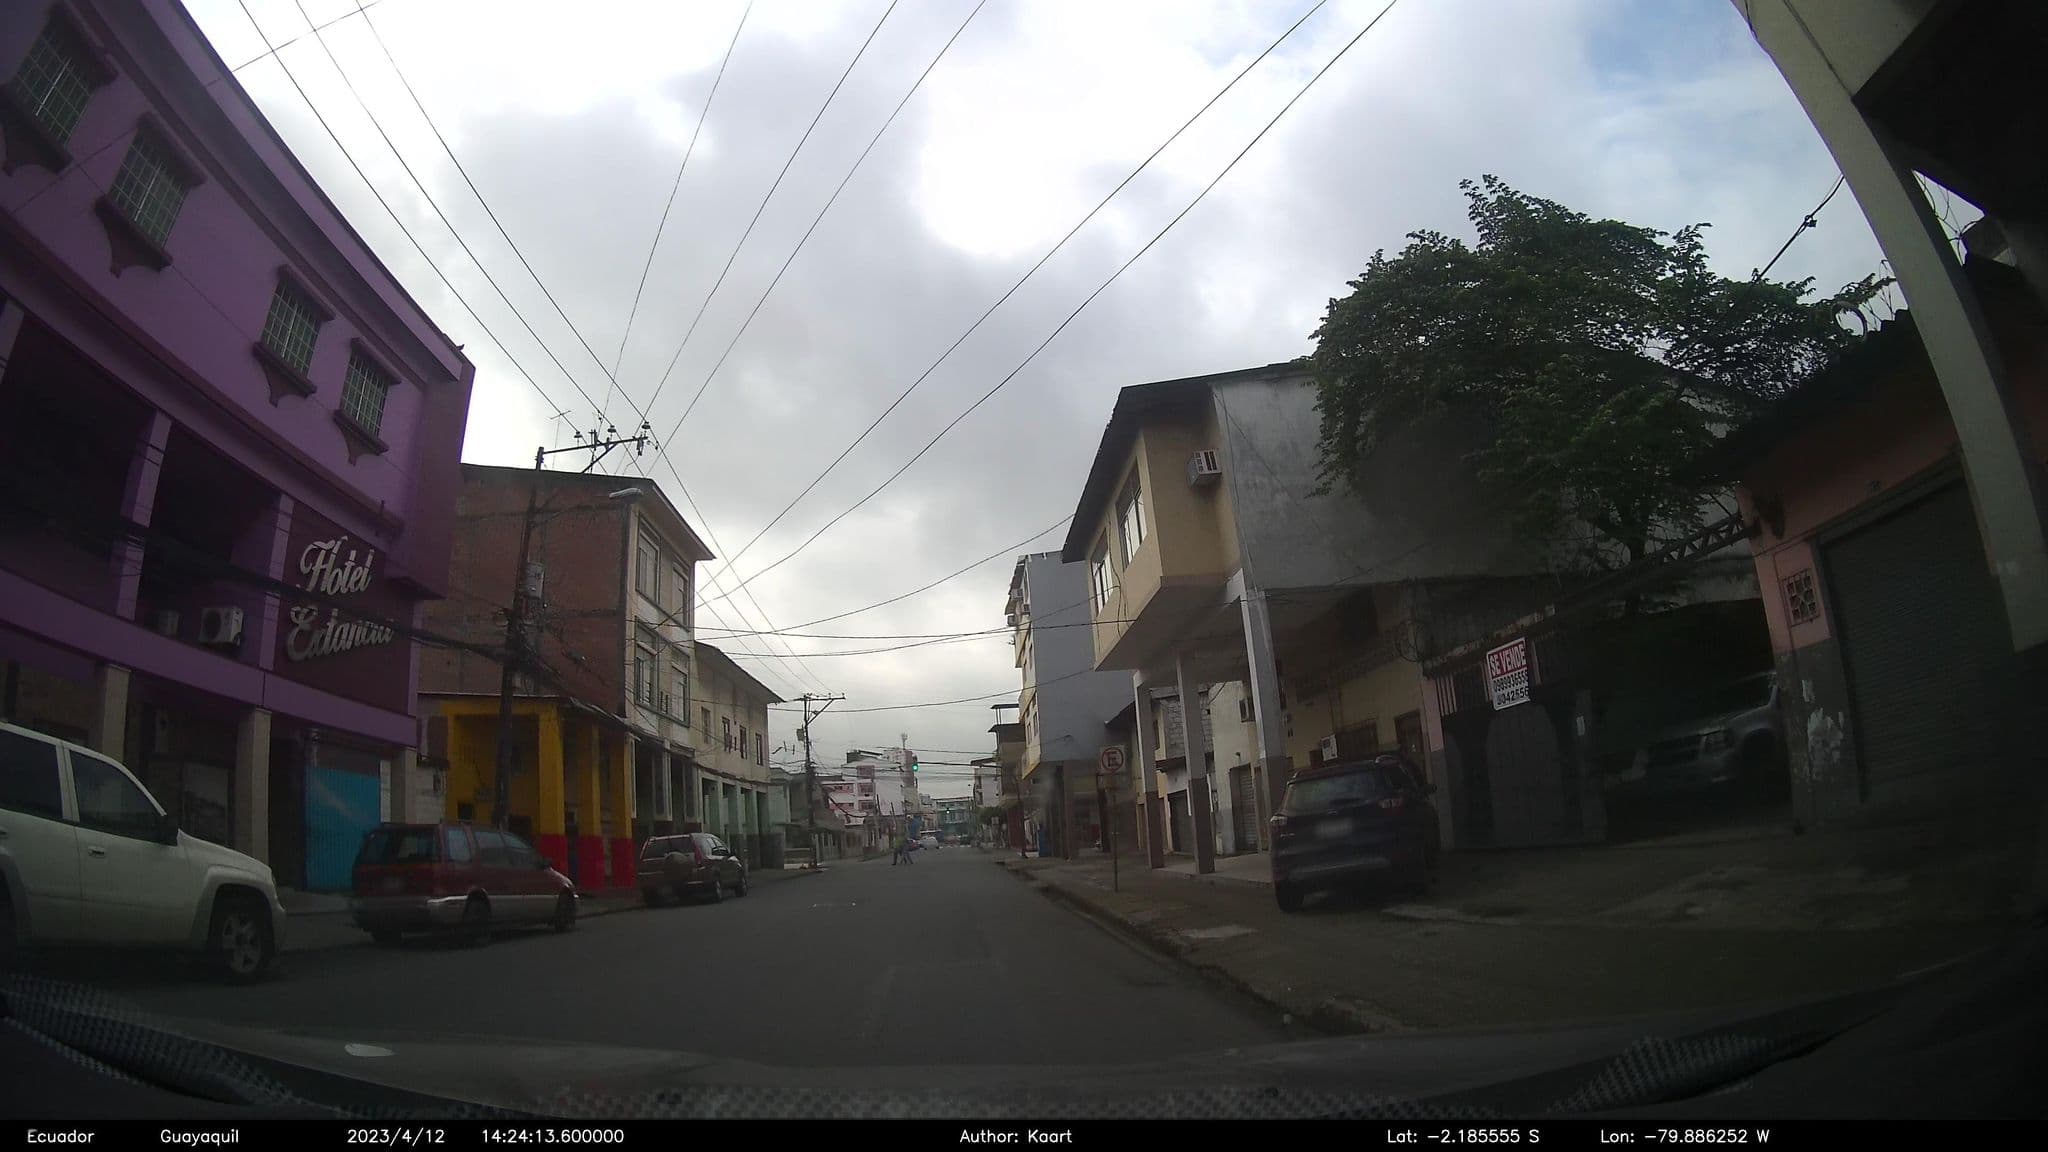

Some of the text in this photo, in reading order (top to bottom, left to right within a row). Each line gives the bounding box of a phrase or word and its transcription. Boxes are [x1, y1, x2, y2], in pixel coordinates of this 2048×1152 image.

[296, 535, 374, 596] Hotel
[1489, 643, 1527, 677] SE VENDE
